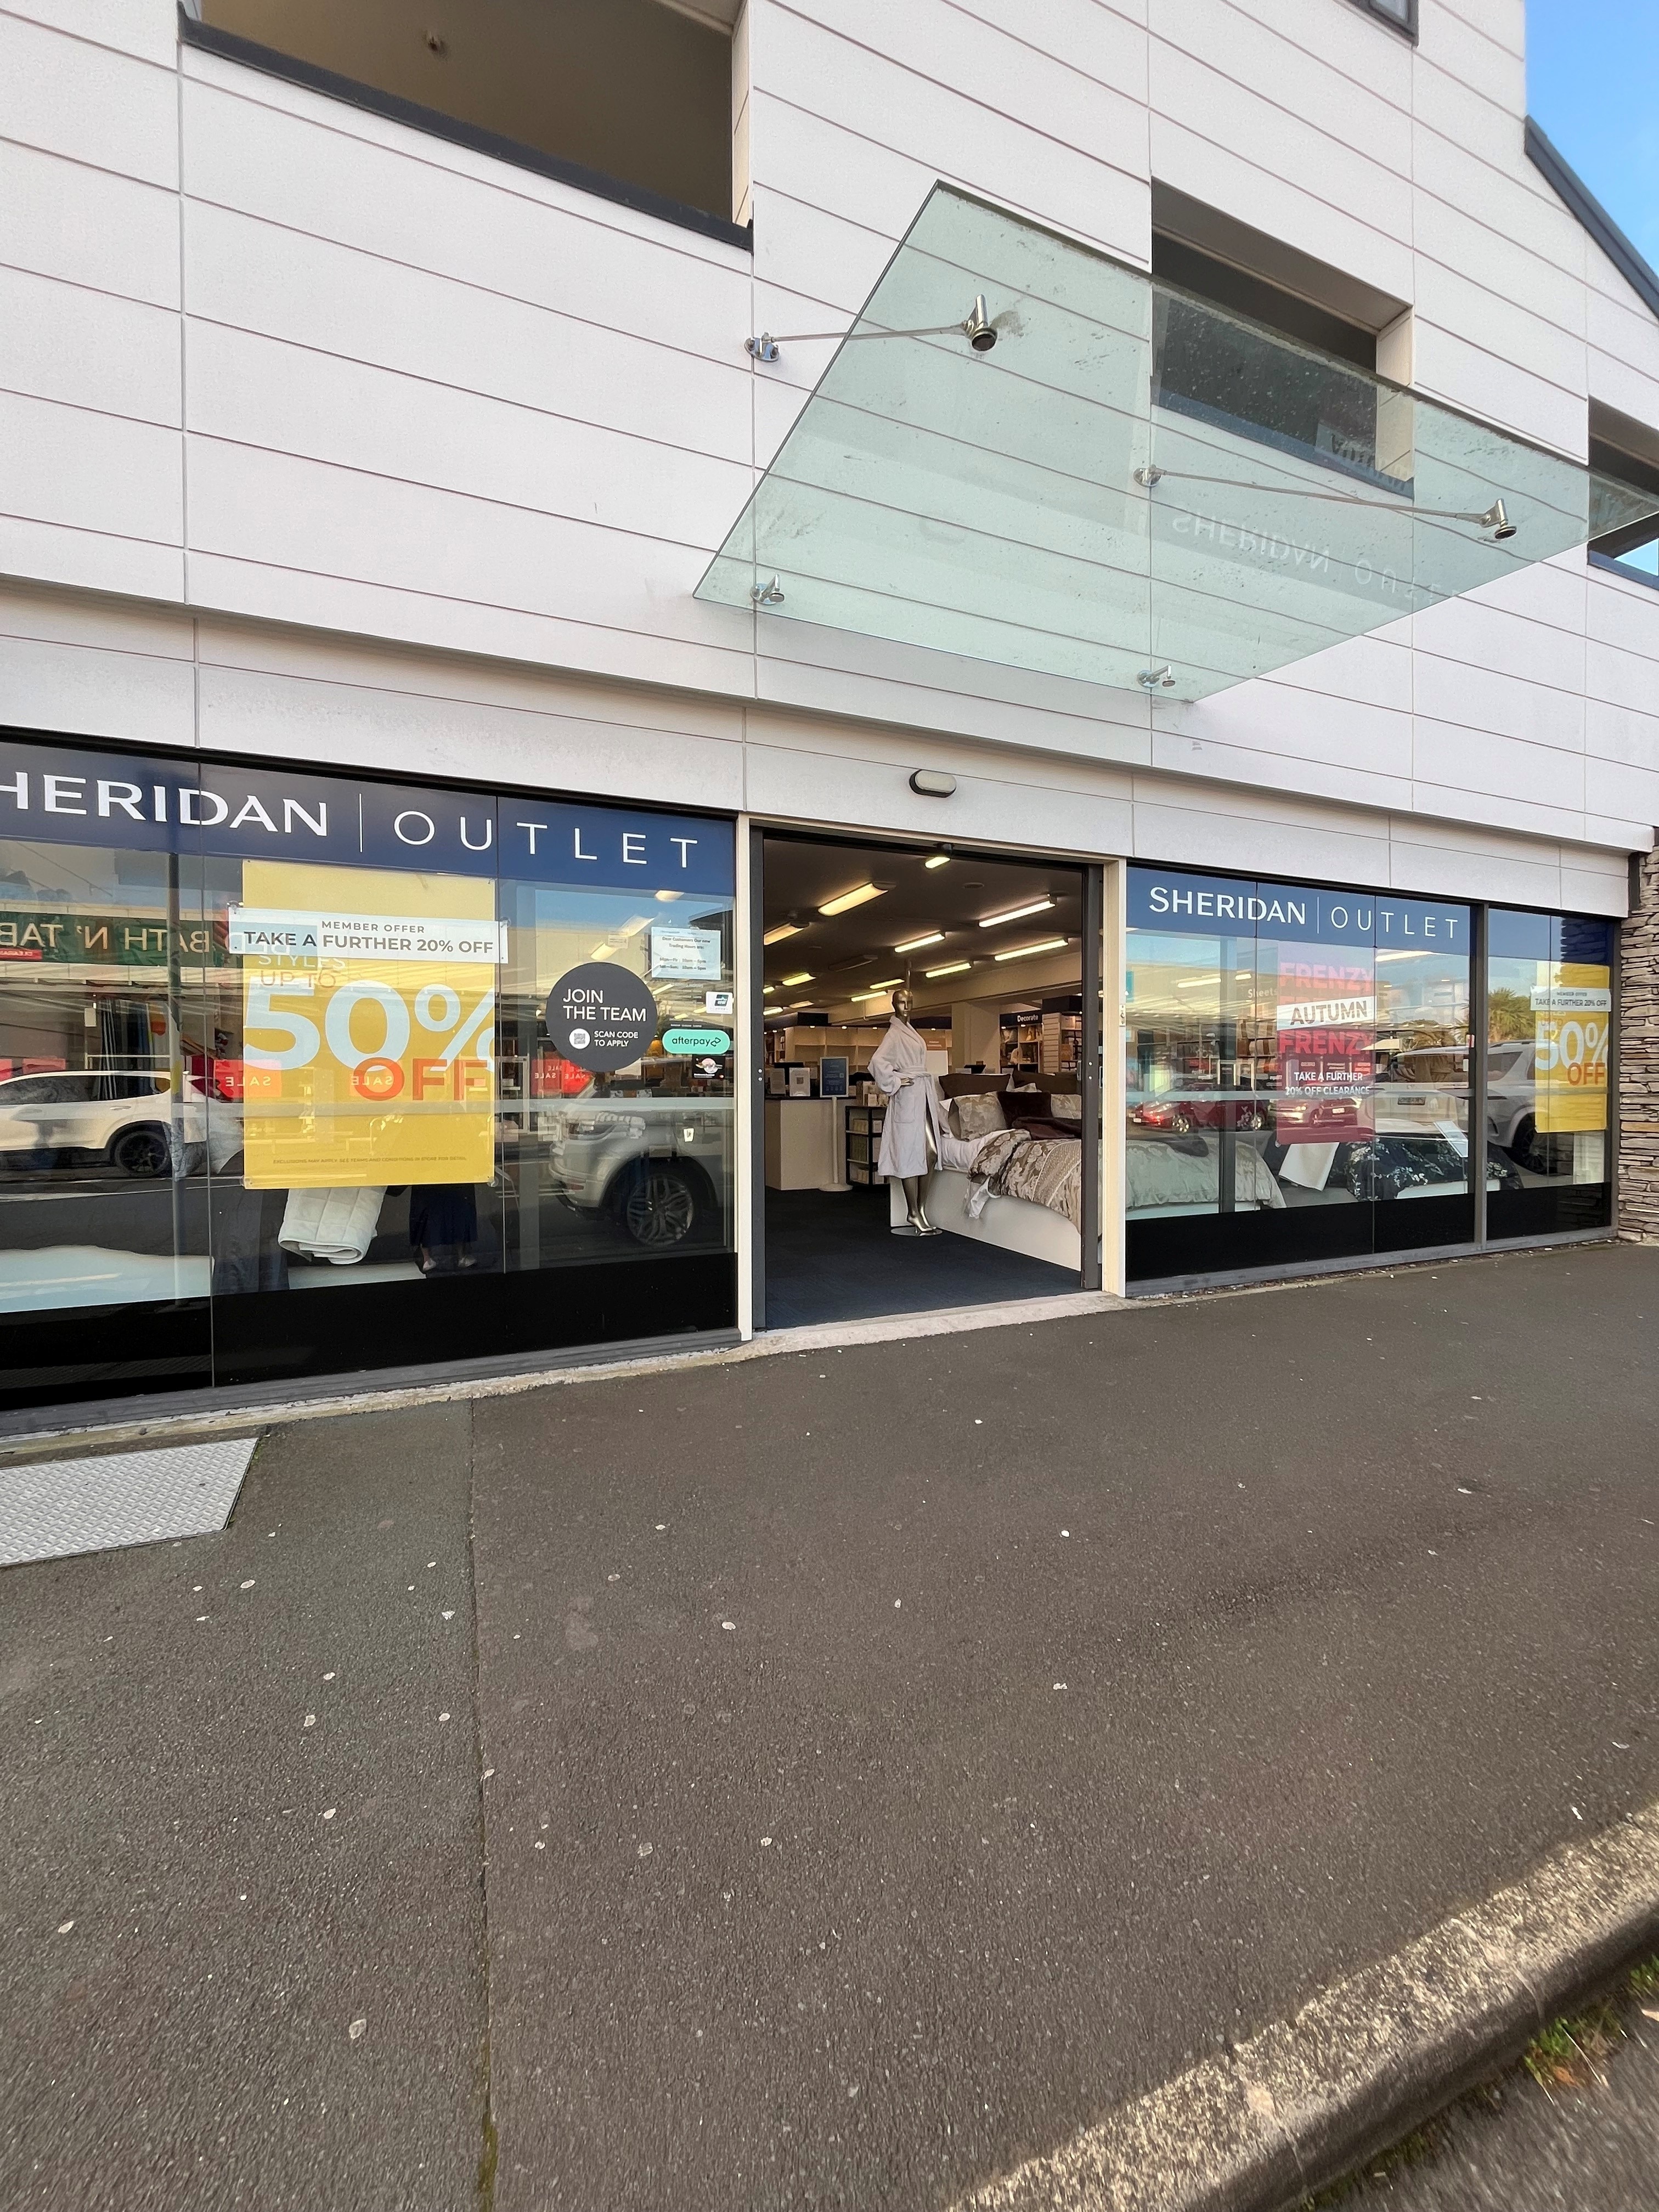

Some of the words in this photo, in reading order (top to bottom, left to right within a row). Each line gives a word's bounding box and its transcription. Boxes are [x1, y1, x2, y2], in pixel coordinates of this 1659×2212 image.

[394, 810, 698, 868] OUTLET
[1149, 887, 1305, 925] SHERIDAN
[1331, 906, 1458, 939] OUTLET
[321, 921, 379, 932] MEMBER
[384, 924, 425, 933] OFFER
[244, 931, 296, 946] TAKE
[302, 933, 317, 947] A
[323, 935, 411, 951] FURTHER
[417, 939, 454, 953] 20%
[459, 940, 494, 954] OFF
[258, 955, 346, 969] STYLES
[260, 970, 296, 987] UP
[303, 969, 337, 989] TO
[562, 989, 603, 1003] JOIN
[562, 1006, 596, 1020] THE
[600, 1007, 646, 1022] TEAM
[1290, 1000, 1368, 1026] AUTUMN
[244, 976, 495, 1072] 50%
[594, 1030, 615, 1039] SCAN
[672, 1036, 710, 1046] afterpay
[1535, 1021, 1609, 1070] 50%
[353, 1057, 488, 1101] OFF
[1294, 1072, 1316, 1081] TAKE
[1318, 1072, 1325, 1081] A
[1326, 1072, 1363, 1081] FURTHER
[1567, 1062, 1605, 1086] OFF
[1285, 1087, 1302, 1096] 20%
[1304, 1086, 1322, 1096] OFF
[1323, 1086, 1370, 1096] CLEARANCE
